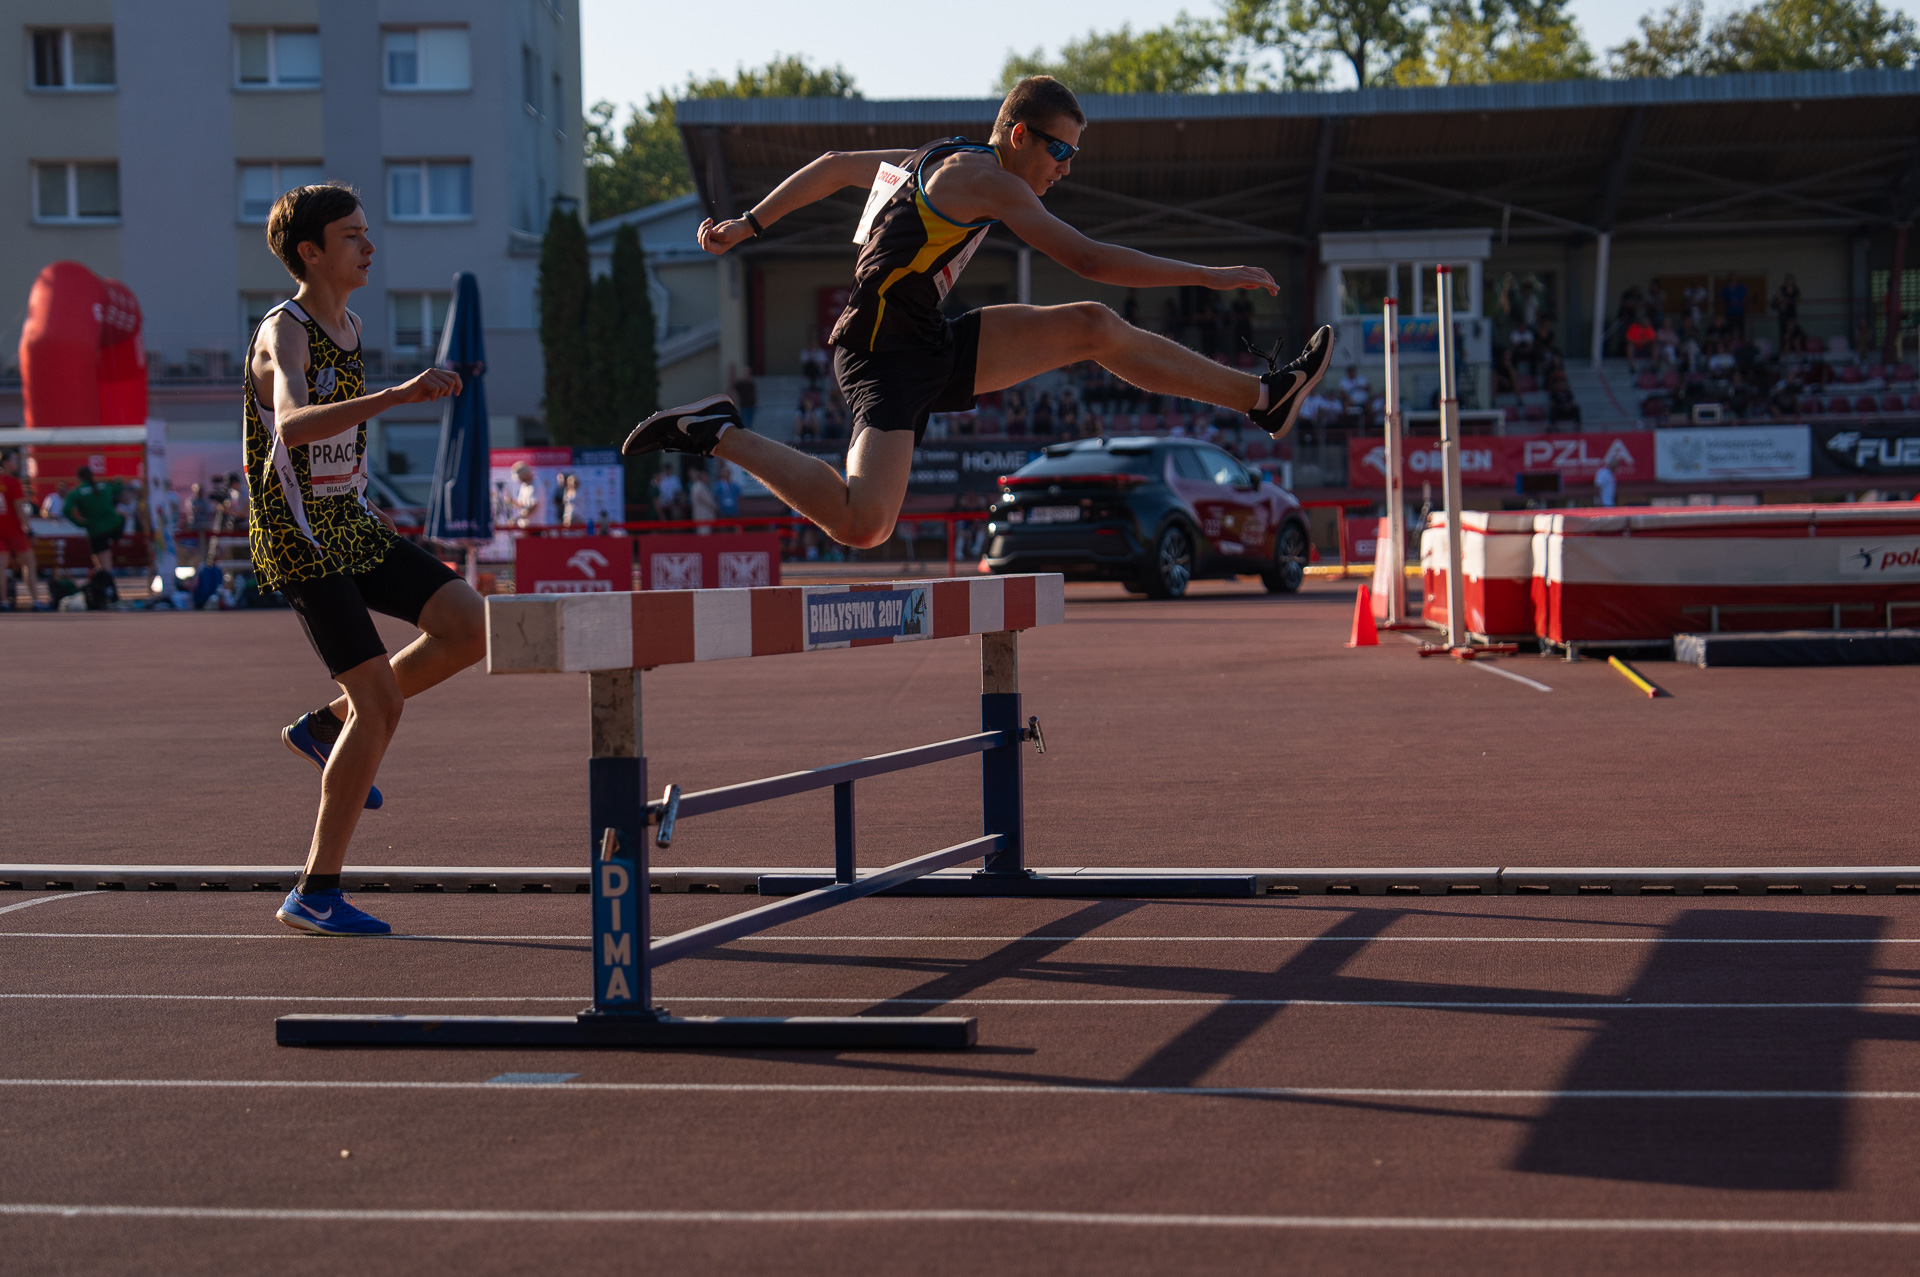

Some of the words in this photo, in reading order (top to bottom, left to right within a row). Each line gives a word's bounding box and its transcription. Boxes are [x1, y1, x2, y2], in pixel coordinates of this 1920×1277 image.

[878, 170, 901, 187] ORLEN
[961, 450, 1028, 473] HOME
[1408, 449, 1493, 473] OREN
[1523, 438, 1635, 468] PZLA
[810, 601, 876, 634] BIAŁYSTOK
[878, 599, 903, 628] 2017
[601, 864, 632, 1000] DIMA
